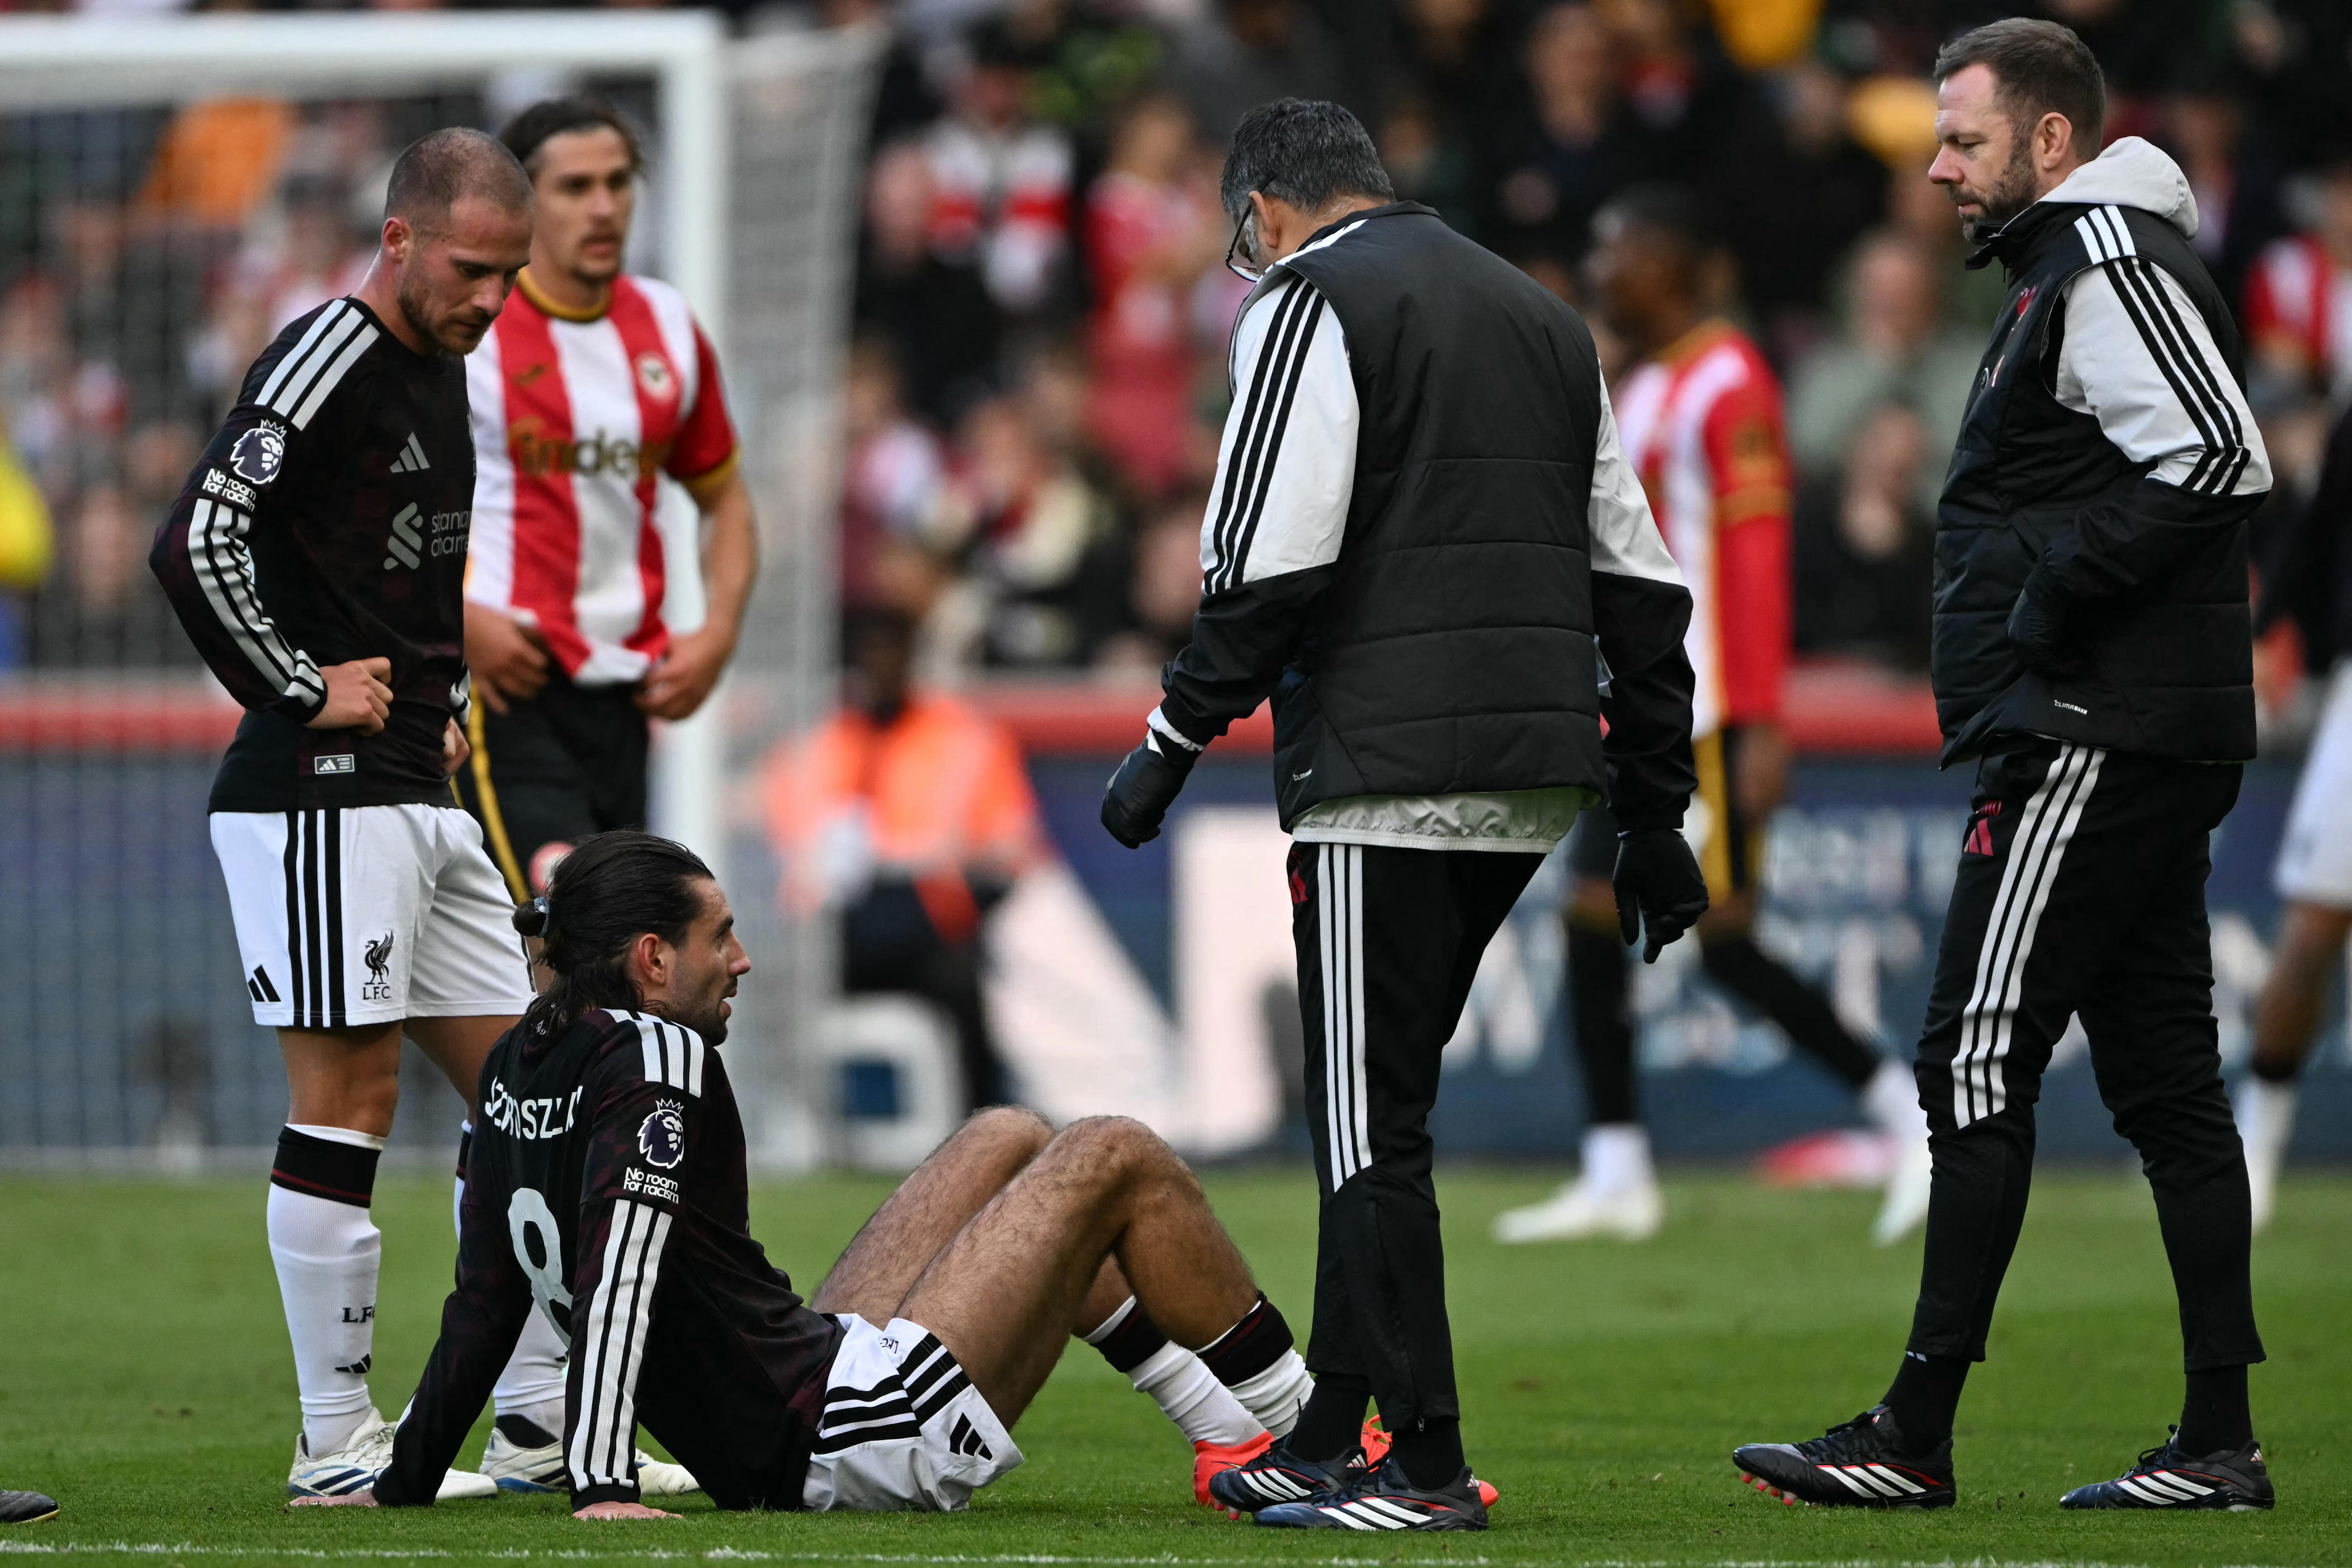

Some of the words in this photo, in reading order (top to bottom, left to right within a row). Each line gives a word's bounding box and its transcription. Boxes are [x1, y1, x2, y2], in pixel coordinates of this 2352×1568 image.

[202, 478, 223, 494] for
[221, 488, 256, 512] racism
[206, 468, 226, 485] No
[226, 478, 257, 501] room
[623, 1178, 643, 1191] for
[643, 1184, 679, 1204] racism
[625, 1166, 644, 1181] No
[645, 1173, 678, 1192] room
[508, 1187, 573, 1350] 8
